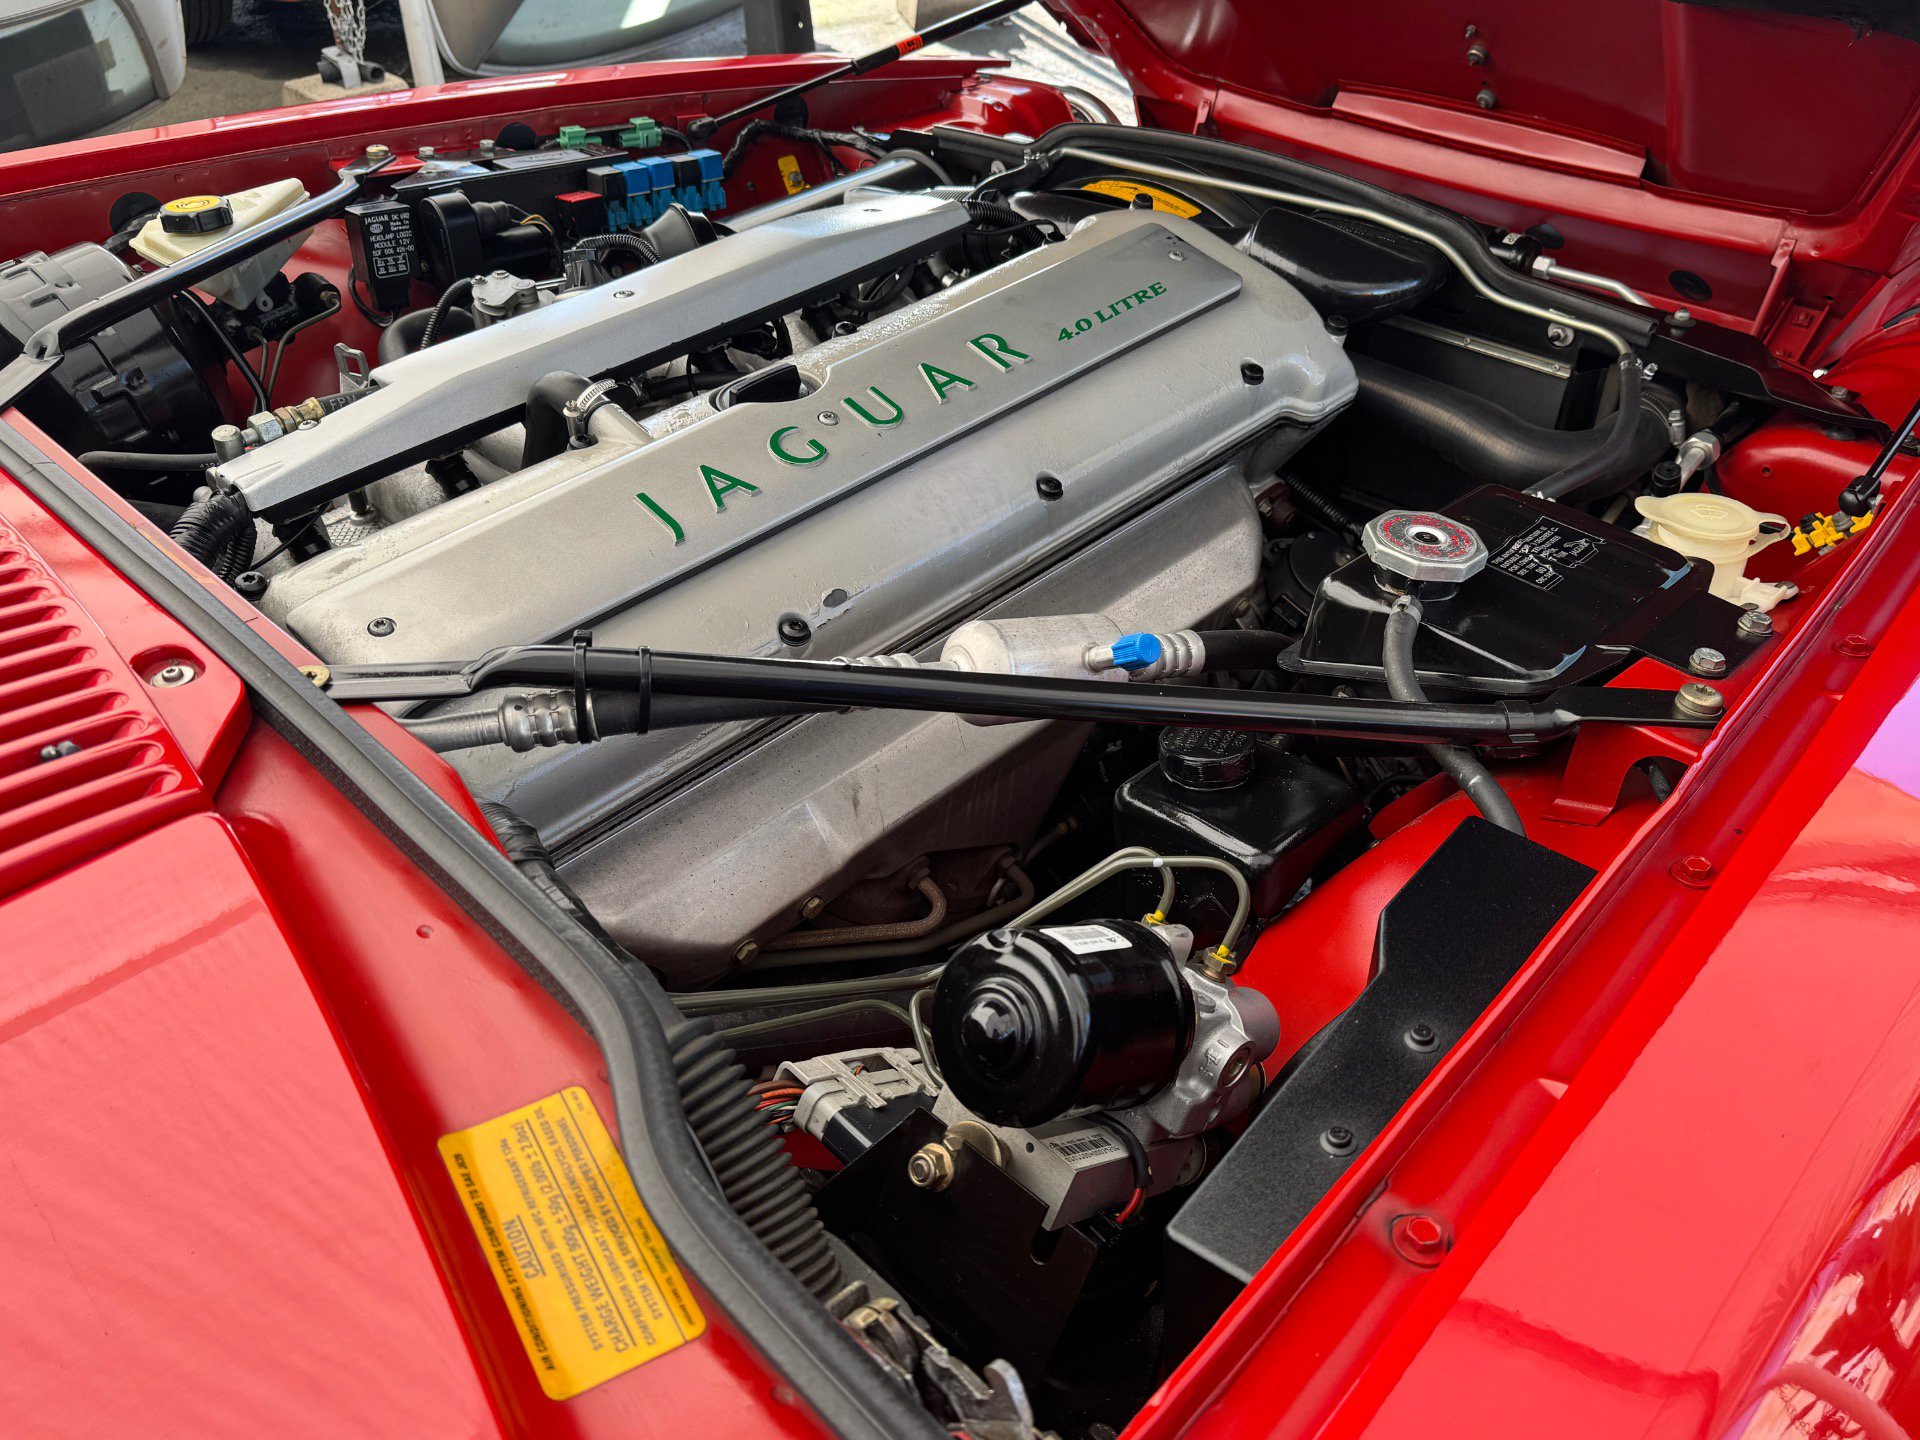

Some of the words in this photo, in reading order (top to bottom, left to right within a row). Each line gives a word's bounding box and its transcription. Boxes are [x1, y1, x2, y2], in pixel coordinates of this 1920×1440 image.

[365, 215, 389, 224] JAGUAR
[370, 233, 394, 242] HEADLAMP
[374, 240, 396, 249] MODULE
[1058, 318, 1092, 342] 4.0
[1094, 282, 1167, 324] LITRE
[632, 332, 1032, 547] JAGUAR
[532, 1105, 546, 1120] OIL
[538, 1118, 559, 1146] BASED
[554, 1115, 586, 1163] PERSONNEL
[460, 1170, 476, 1188] SAE
[468, 1187, 481, 1200] TO
[504, 1155, 539, 1210] REFRIGERANT
[576, 1161, 606, 1204] QUALIFIED
[529, 1209, 547, 1228] HFC
[544, 1192, 567, 1216] 50g
[597, 1201, 613, 1217] BY
[473, 1200, 502, 1248] CONFORMS
[538, 1226, 558, 1252] WITH
[557, 1222, 585, 1254] 900g
[603, 1214, 633, 1258] SERVICED
[494, 1246, 518, 1285] SYSTEM
[500, 1216, 541, 1281] CAUTION
[594, 1232, 627, 1284] LUBRICANT
[624, 1255, 640, 1271] BE
[549, 1251, 586, 1313] PRESSURISED
[570, 1251, 605, 1302] WEIGHT
[630, 1268, 646, 1283] TO
[511, 1285, 548, 1354] CONDITIONING
[618, 1282, 657, 1346] COMPRESSOR
[637, 1282, 664, 1321] SYSTEM
[577, 1311, 604, 1352] SYSTEM
[594, 1299, 630, 1354] CHARGE
[541, 1353, 556, 1372] AIR
